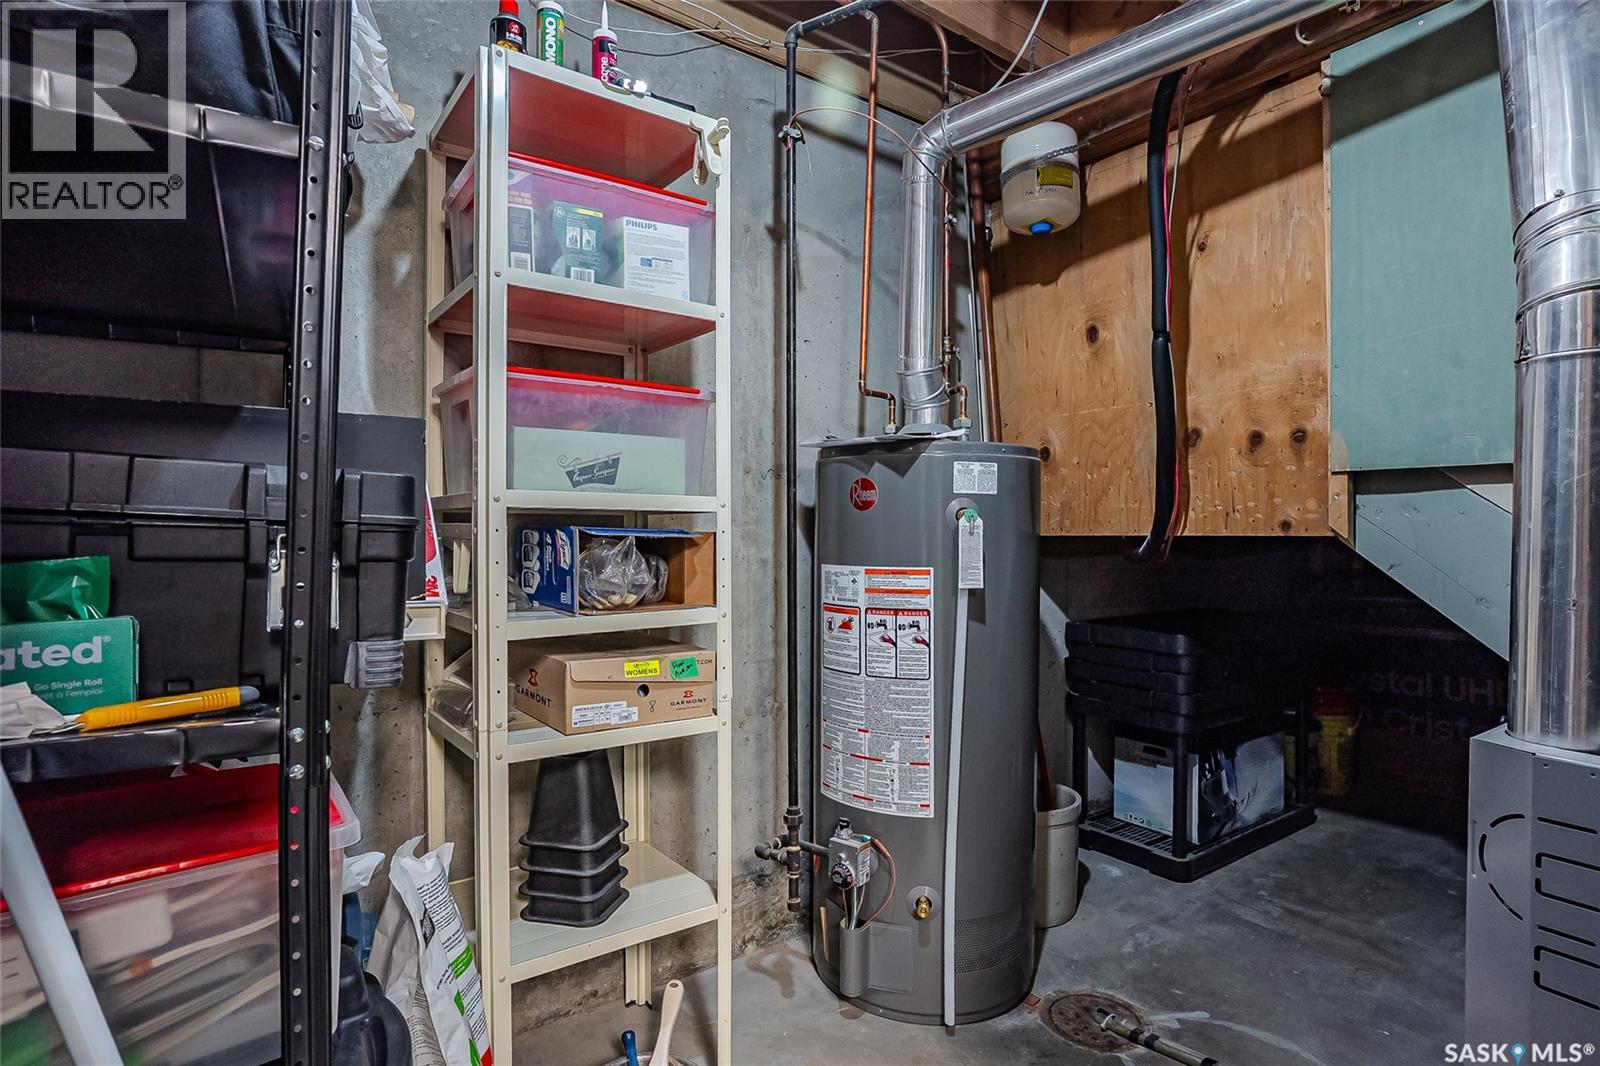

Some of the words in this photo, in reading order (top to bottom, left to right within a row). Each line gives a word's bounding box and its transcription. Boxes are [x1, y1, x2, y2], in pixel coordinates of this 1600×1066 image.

[545, 17, 556, 64] MONO
[625, 219, 658, 231] PHILIPS
[852, 479, 876, 506] Rheem
[626, 668, 658, 676] WOMENS
[50, 680, 82, 691] Single
[84, 678, 103, 687] Roll
[516, 684, 552, 708] GARMONT
[670, 698, 707, 706] GARMONT
